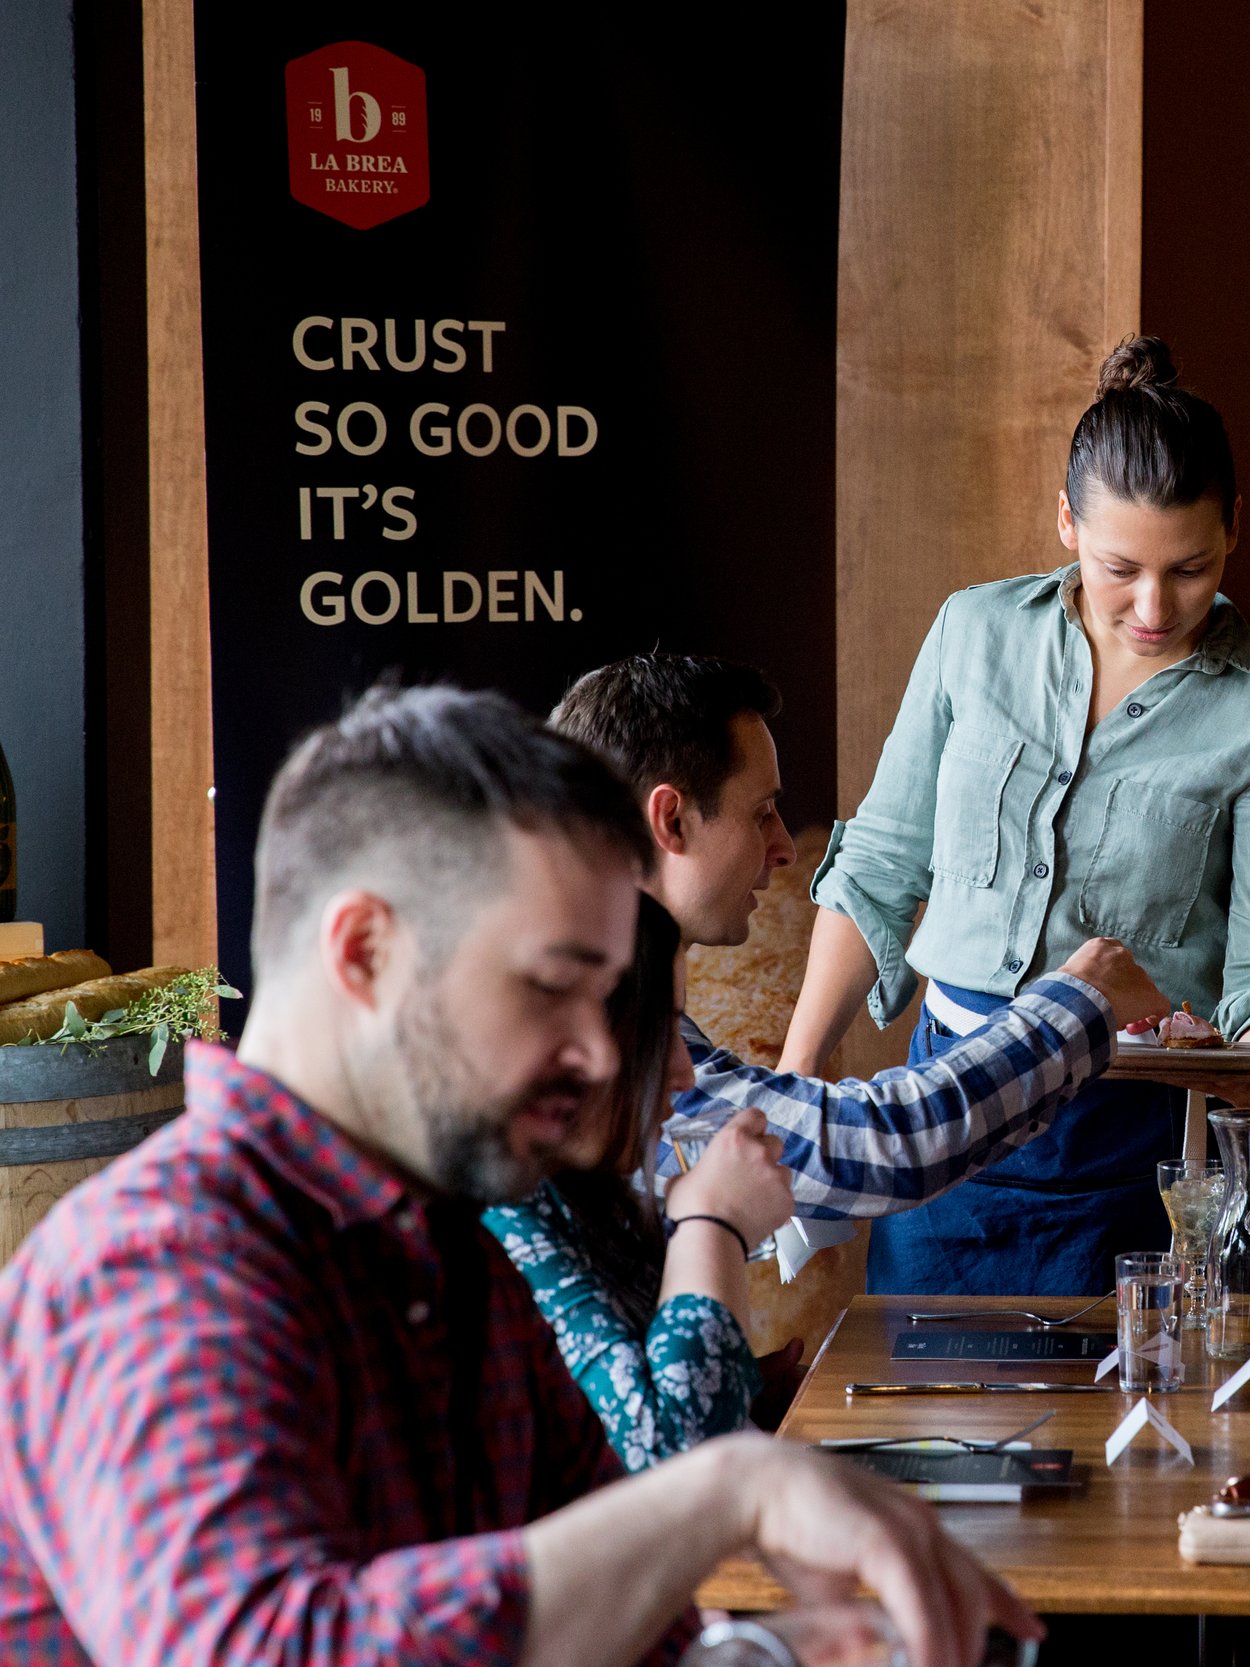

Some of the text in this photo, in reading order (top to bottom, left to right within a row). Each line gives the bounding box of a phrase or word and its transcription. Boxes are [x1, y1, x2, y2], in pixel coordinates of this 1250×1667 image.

[309, 108, 322, 123] 19
[391, 112, 406, 126] 89
[309, 152, 408, 174] LA BREA
[292, 316, 506, 373] CRUST
[295, 401, 598, 458] SO GOOD
[299, 484, 417, 541] IT'S
[300, 569, 583, 626] GOLDEN.
